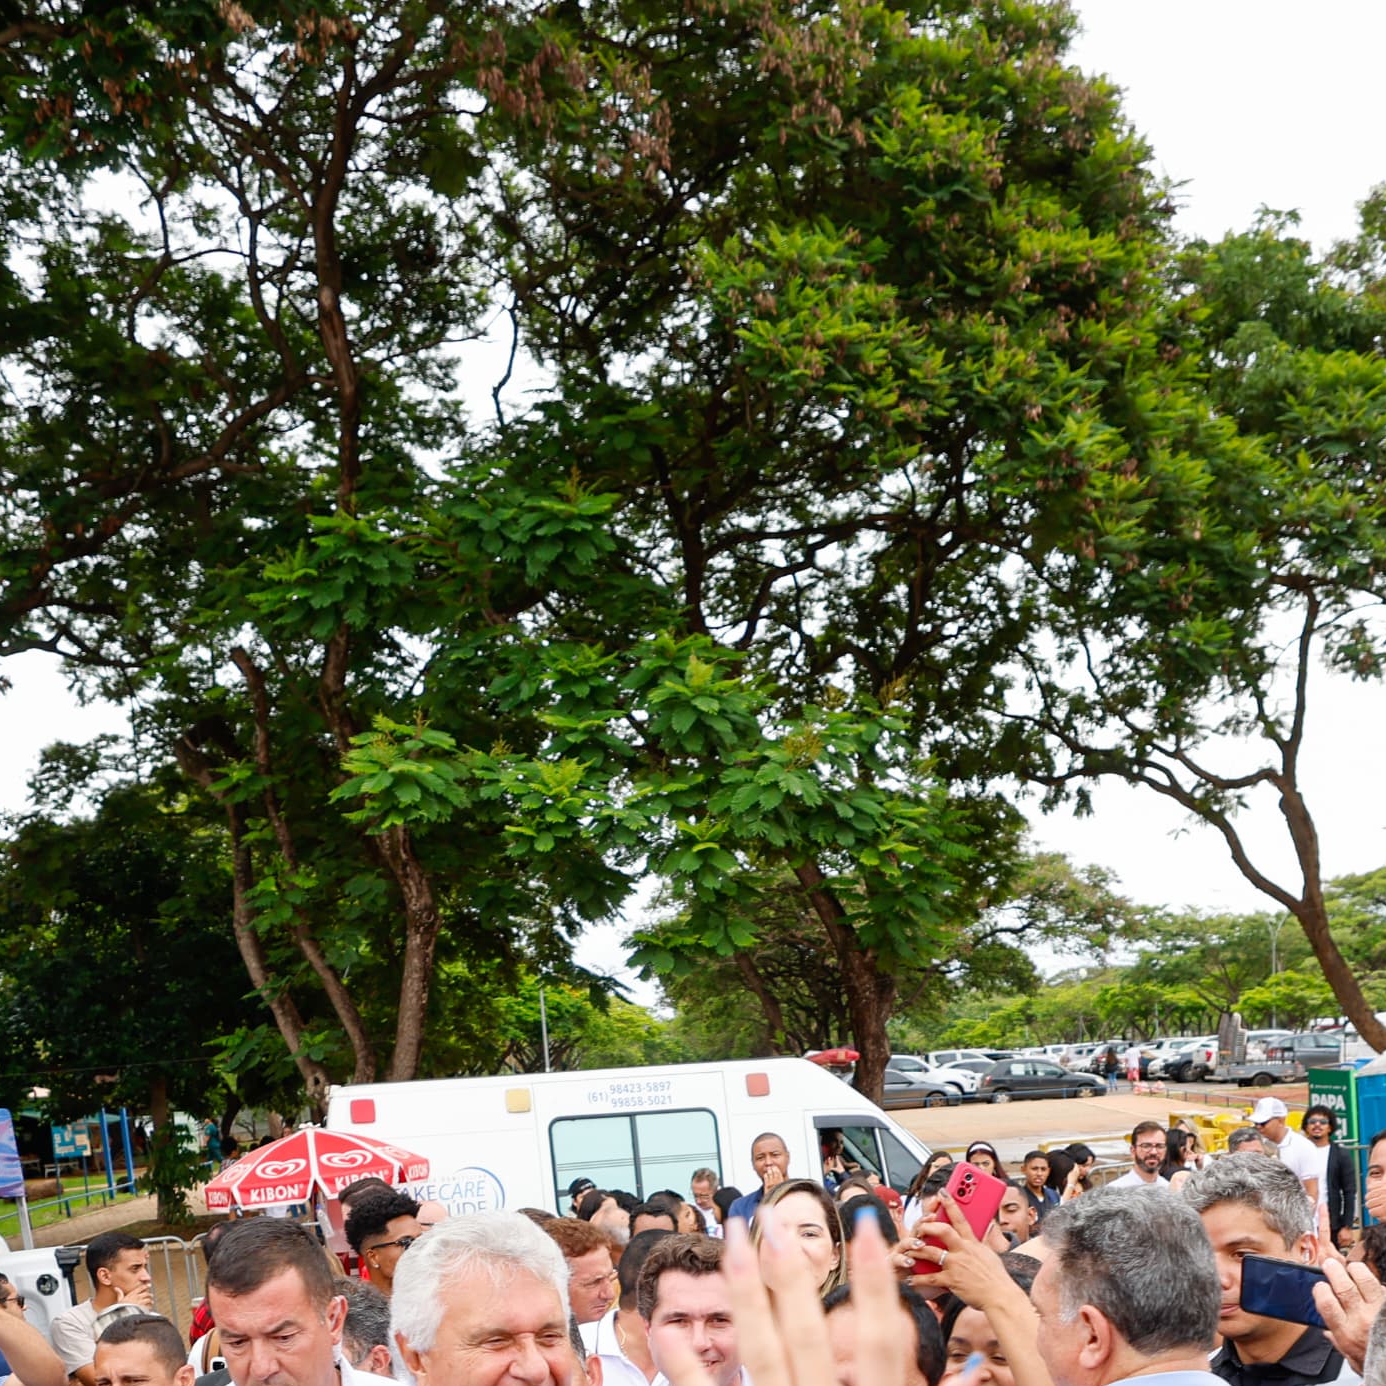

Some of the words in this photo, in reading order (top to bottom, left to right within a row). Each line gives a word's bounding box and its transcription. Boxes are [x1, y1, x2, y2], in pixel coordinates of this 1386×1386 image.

[588, 1092, 608, 1104] (61)
[1311, 1093, 1347, 1111] PAPA
[250, 1183, 299, 1202] KIBON
